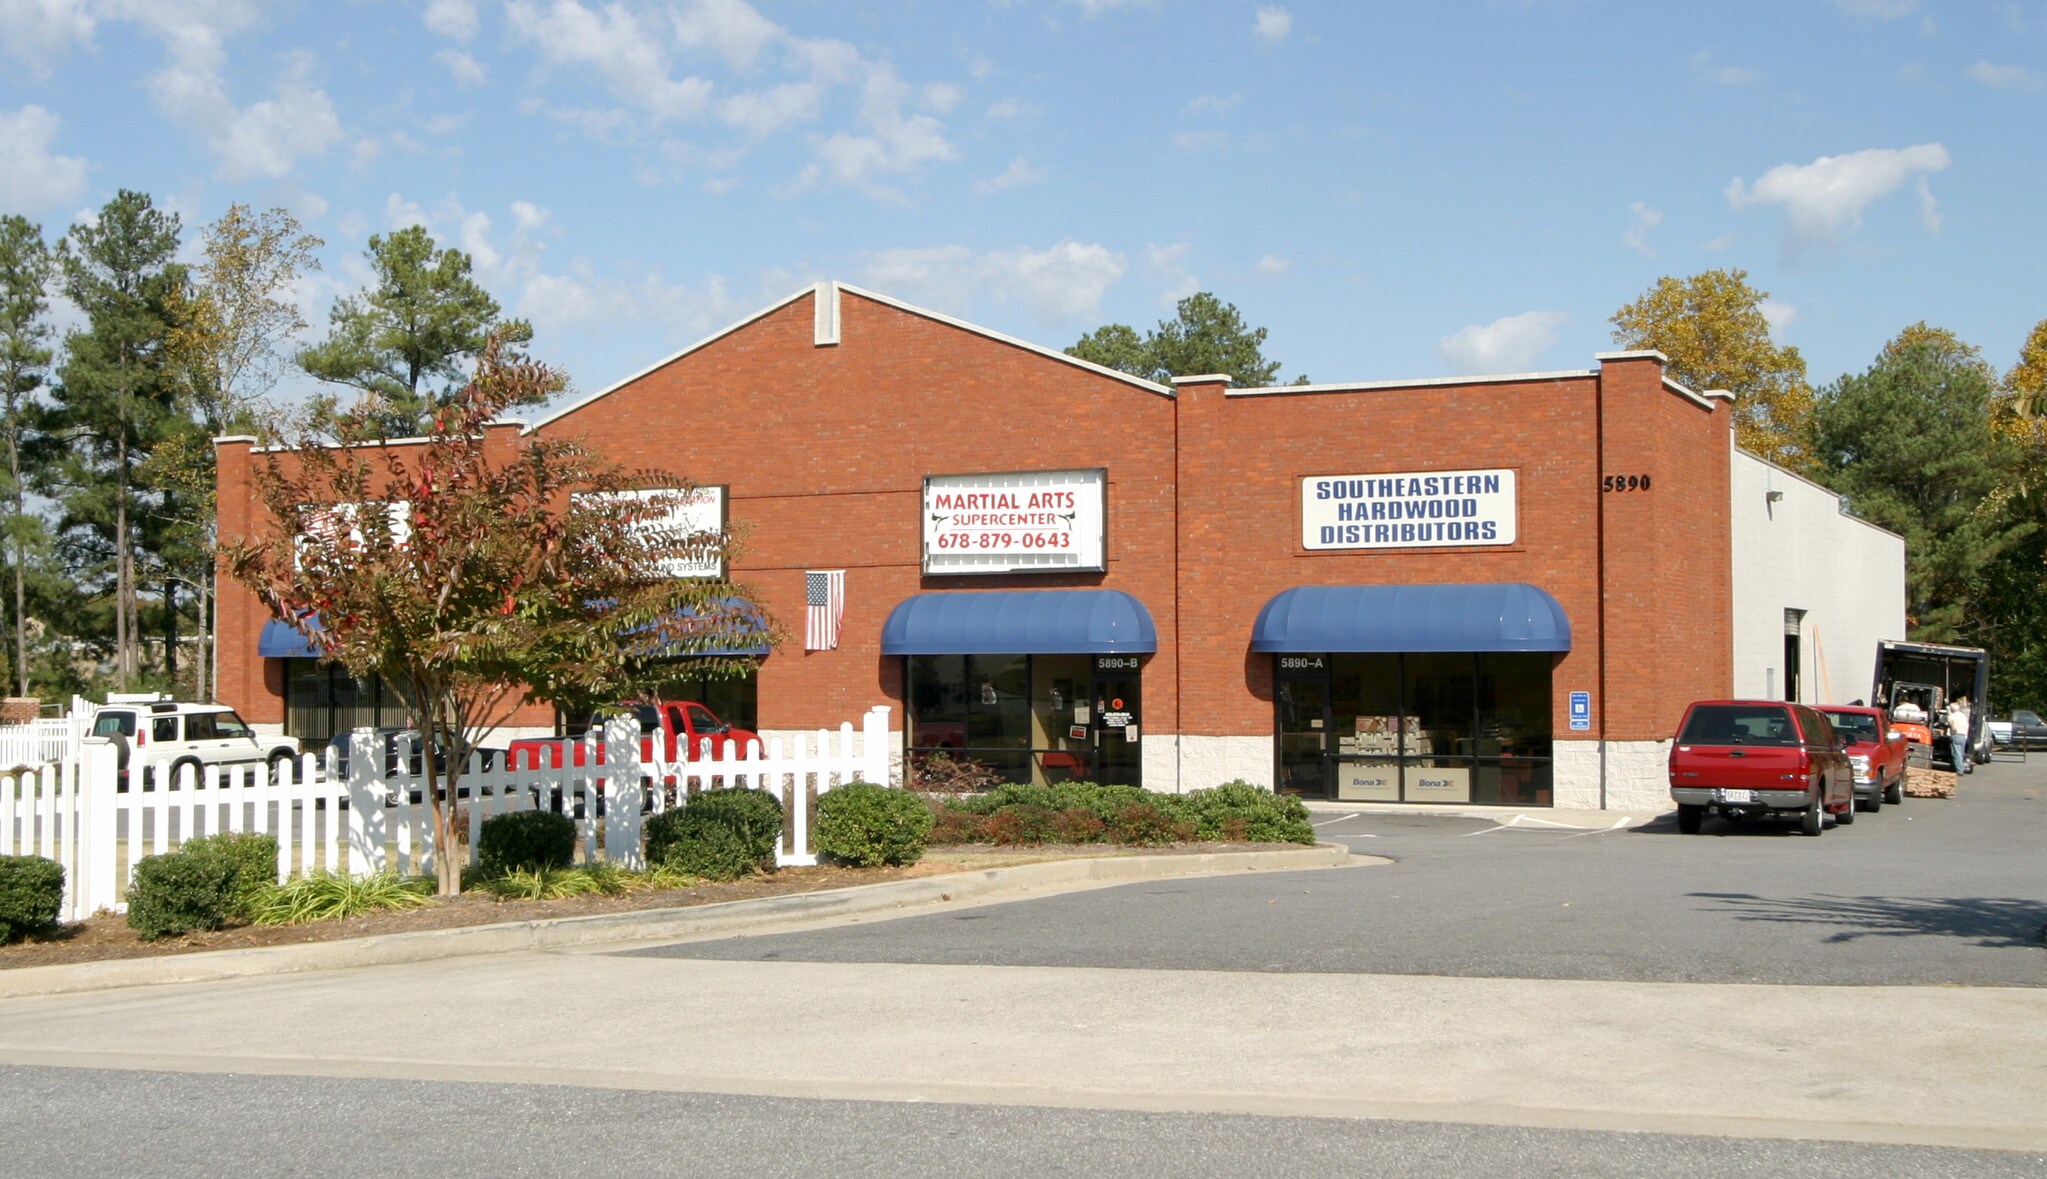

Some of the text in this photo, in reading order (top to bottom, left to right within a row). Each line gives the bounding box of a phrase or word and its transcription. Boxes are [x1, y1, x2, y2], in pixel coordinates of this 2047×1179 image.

[1316, 475, 1500, 500] SOUTHEASTERN
[1603, 474, 1651, 492] 5890
[935, 491, 1075, 510] MARTIAL ARTS
[1338, 498, 1478, 521] HARDWOOD
[952, 513, 1056, 526] SUPERCENTER
[937, 532, 1071, 548] 678-879-0643
[1320, 520, 1497, 544] DISTRIBUTORS
[677, 562, 717, 571] SYSTEMS
[1098, 658, 1138, 669] 5890-B
[1281, 658, 1323, 668] 5890-A
